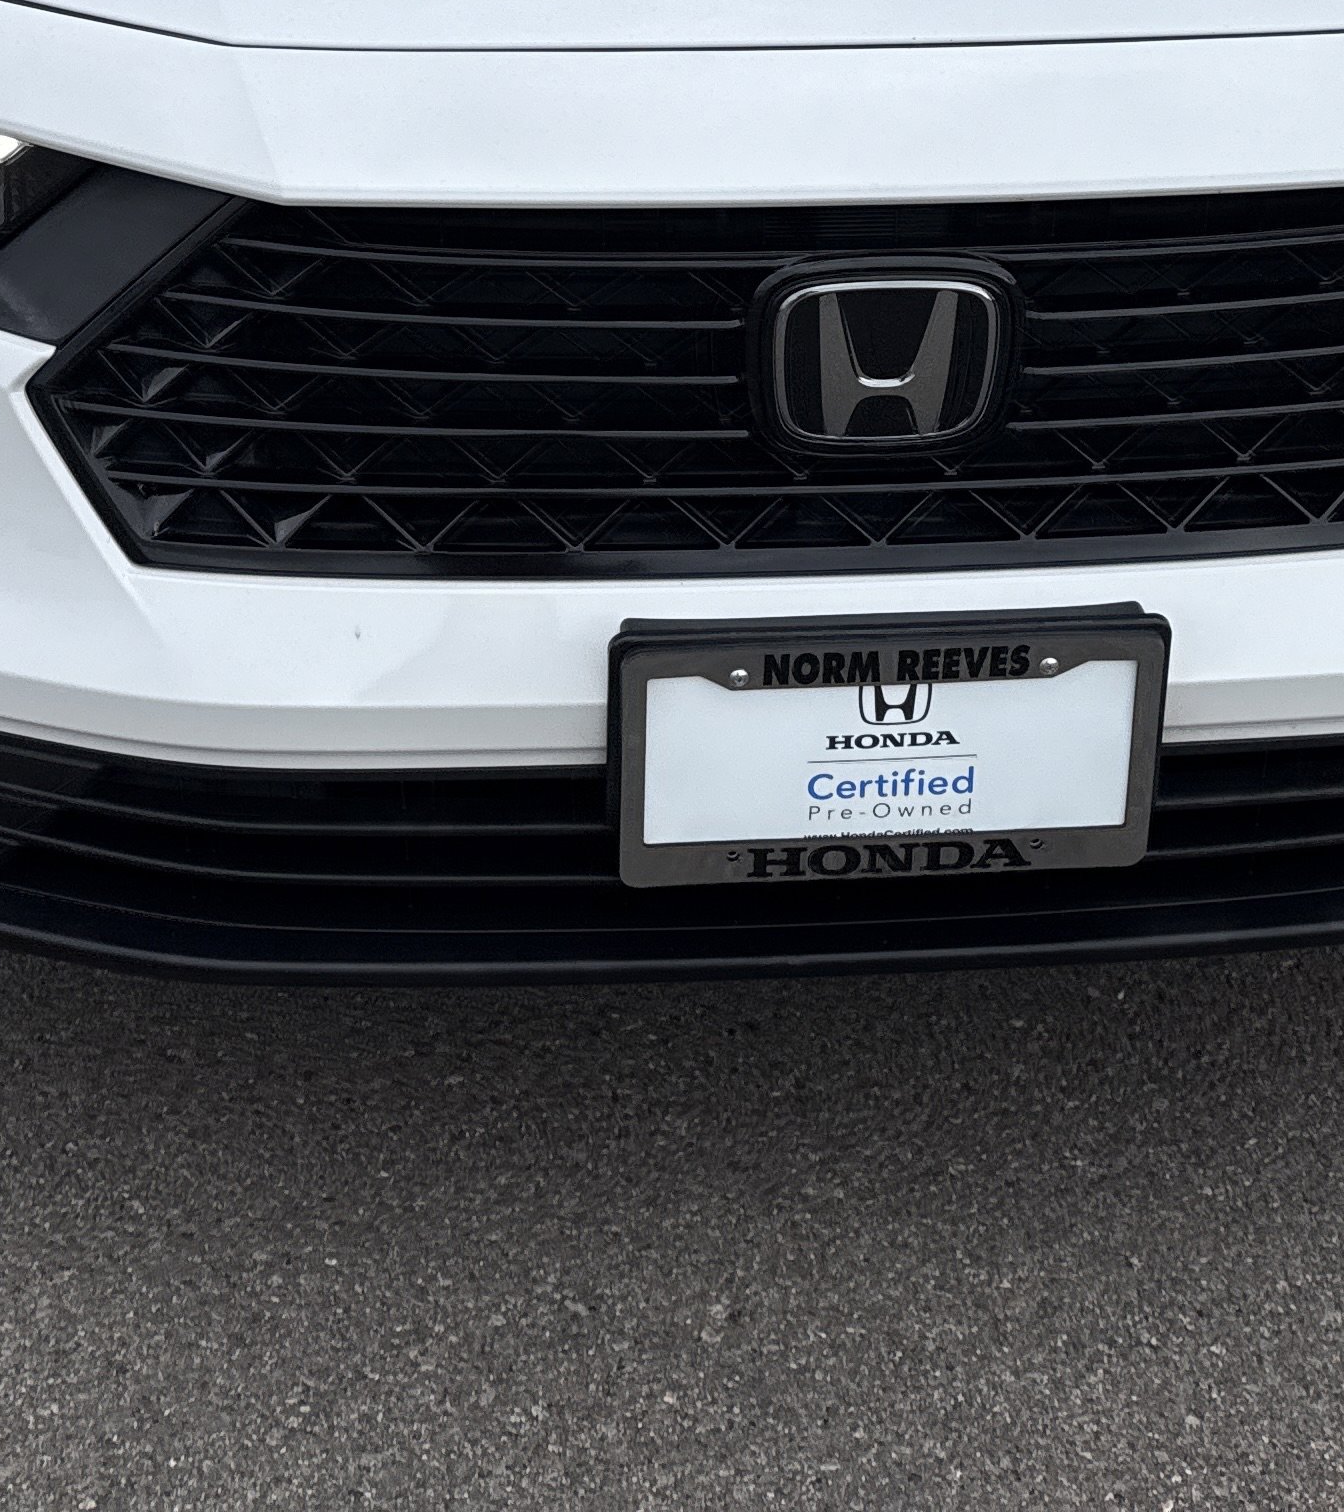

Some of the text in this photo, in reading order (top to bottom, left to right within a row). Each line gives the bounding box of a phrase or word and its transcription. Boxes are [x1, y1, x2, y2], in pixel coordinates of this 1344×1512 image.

[763, 644, 1031, 686] NORM REEVES
[825, 730, 961, 750] HONDA
[807, 766, 975, 801] Certified
[808, 798, 972, 821] Pre-Owned
[746, 838, 1032, 878] HONDA
